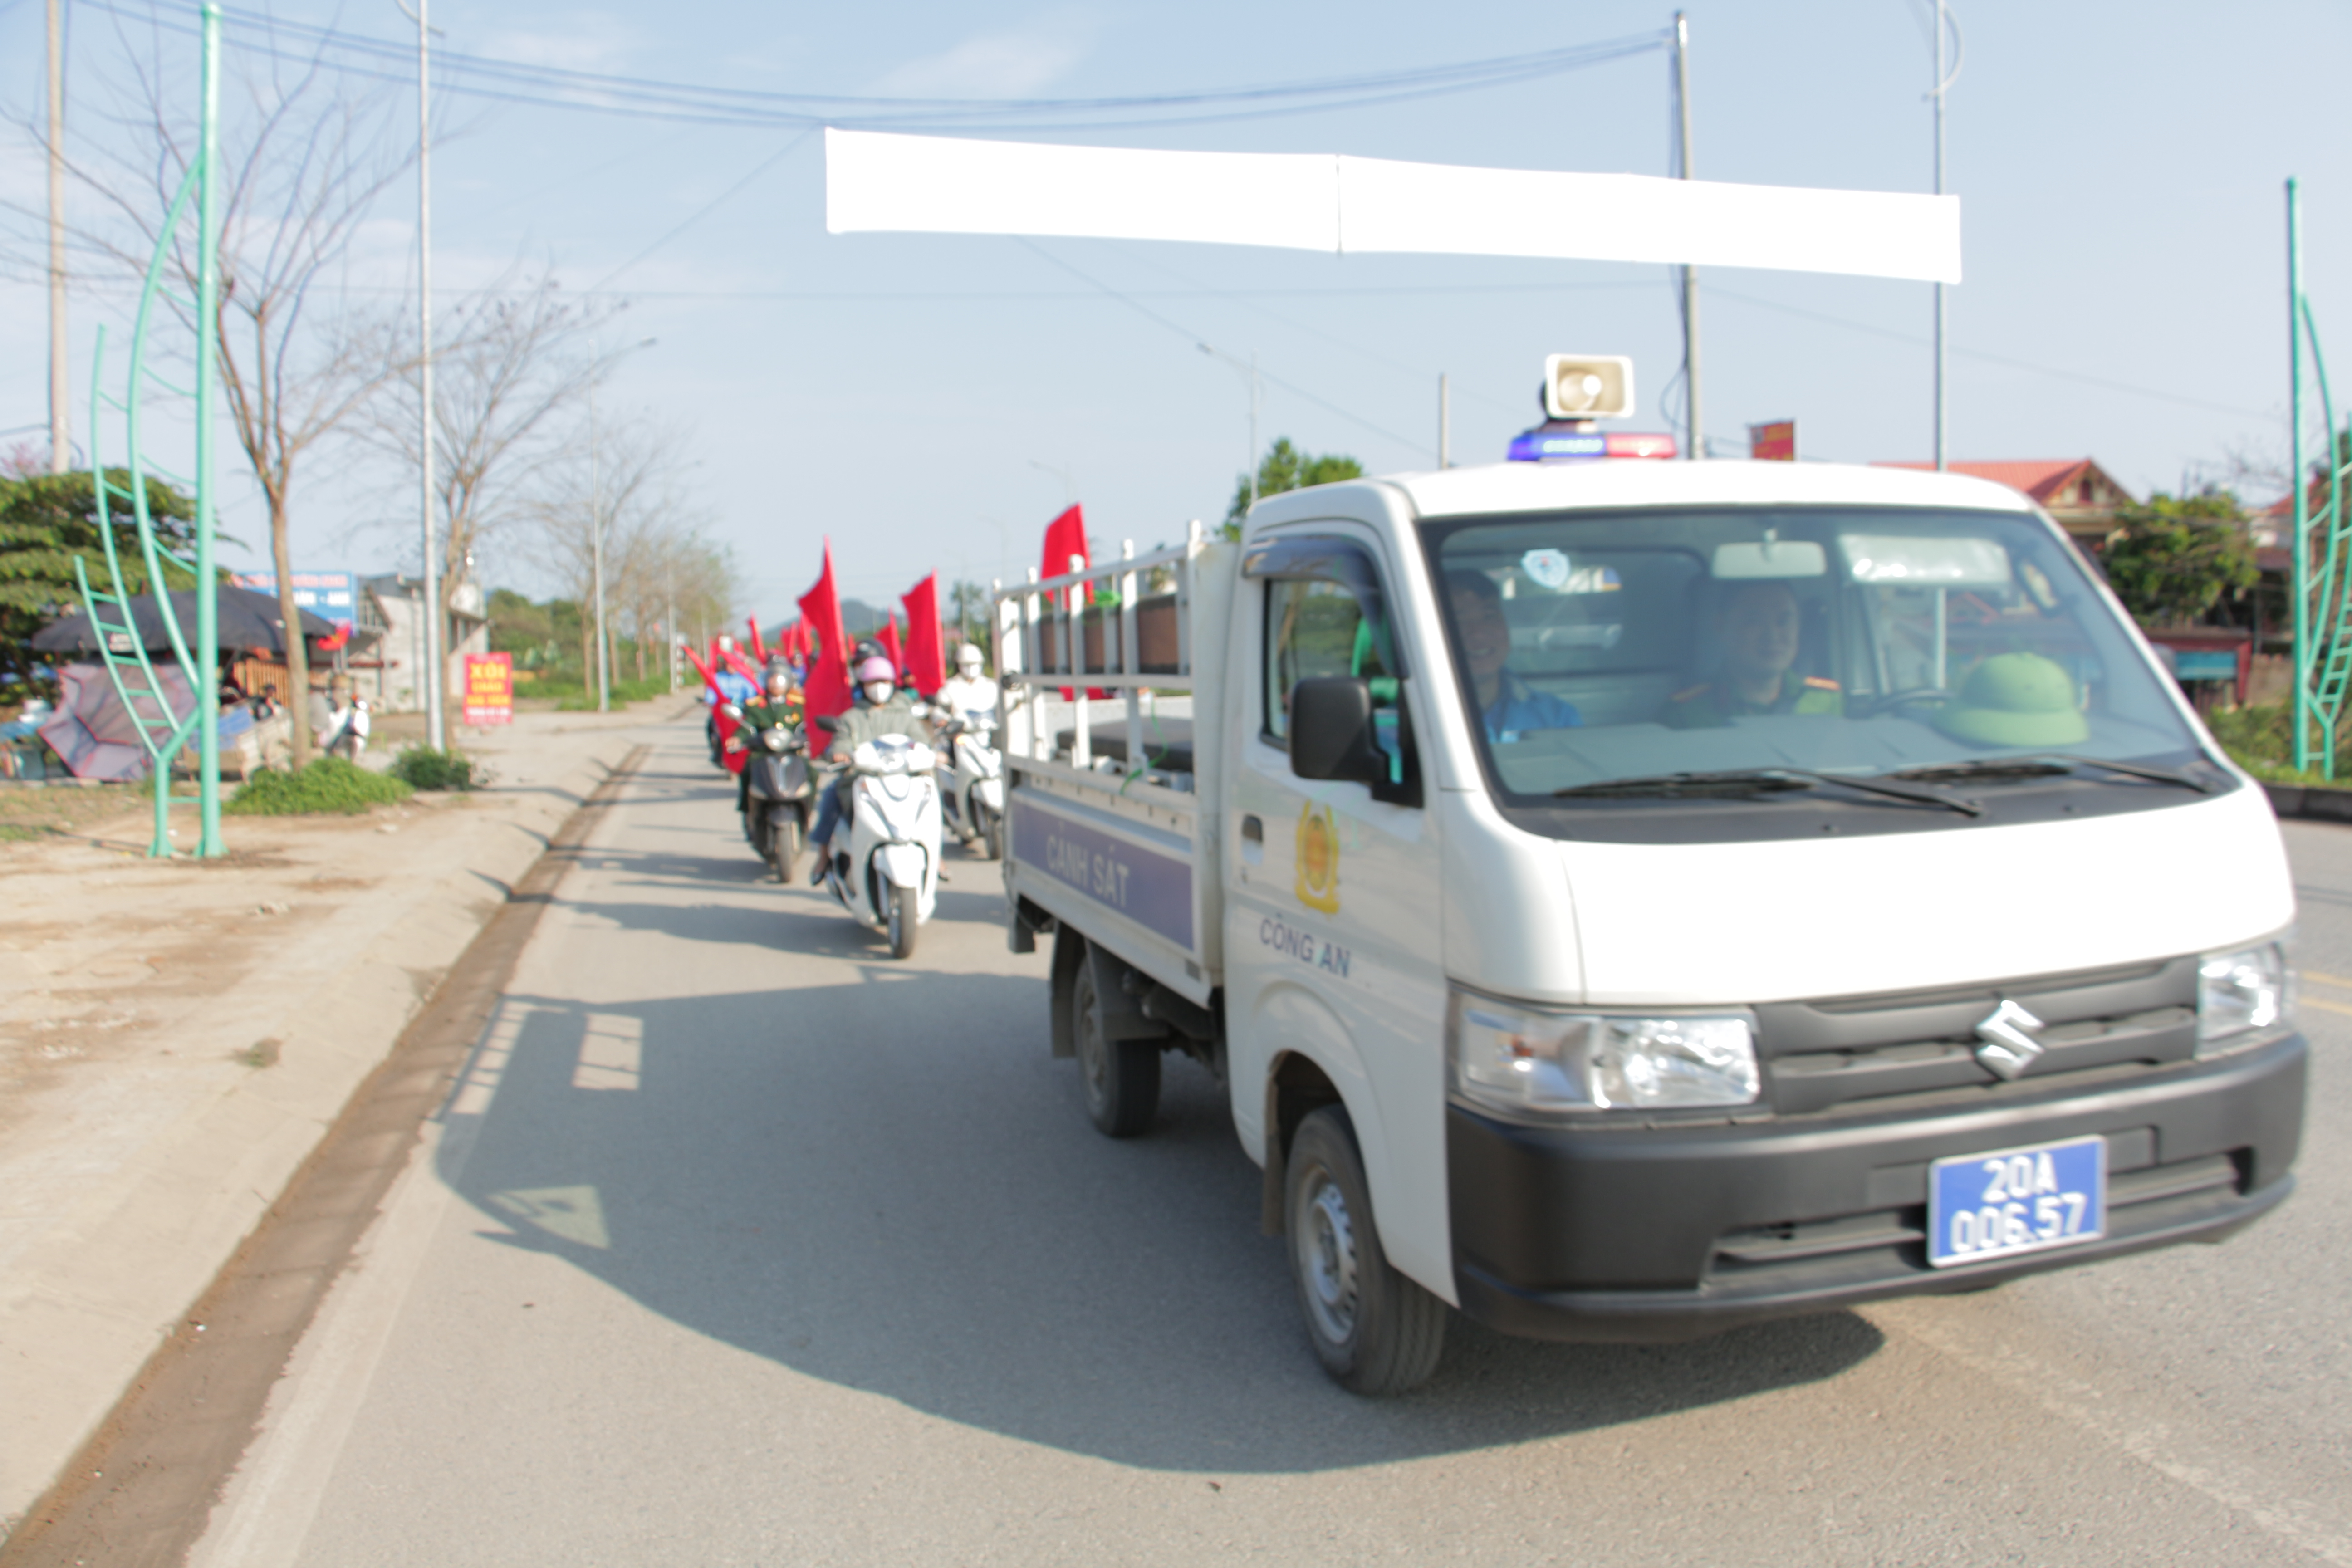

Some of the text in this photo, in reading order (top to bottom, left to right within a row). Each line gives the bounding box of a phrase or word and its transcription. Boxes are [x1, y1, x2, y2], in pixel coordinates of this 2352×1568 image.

[470, 660, 507, 679] XÔI
[1093, 844, 1130, 907] SÁT
[1259, 912, 1352, 978] CÔNG AN
[1981, 1152, 2058, 1203] 20A
[1950, 1191, 2087, 1254] 006.57
